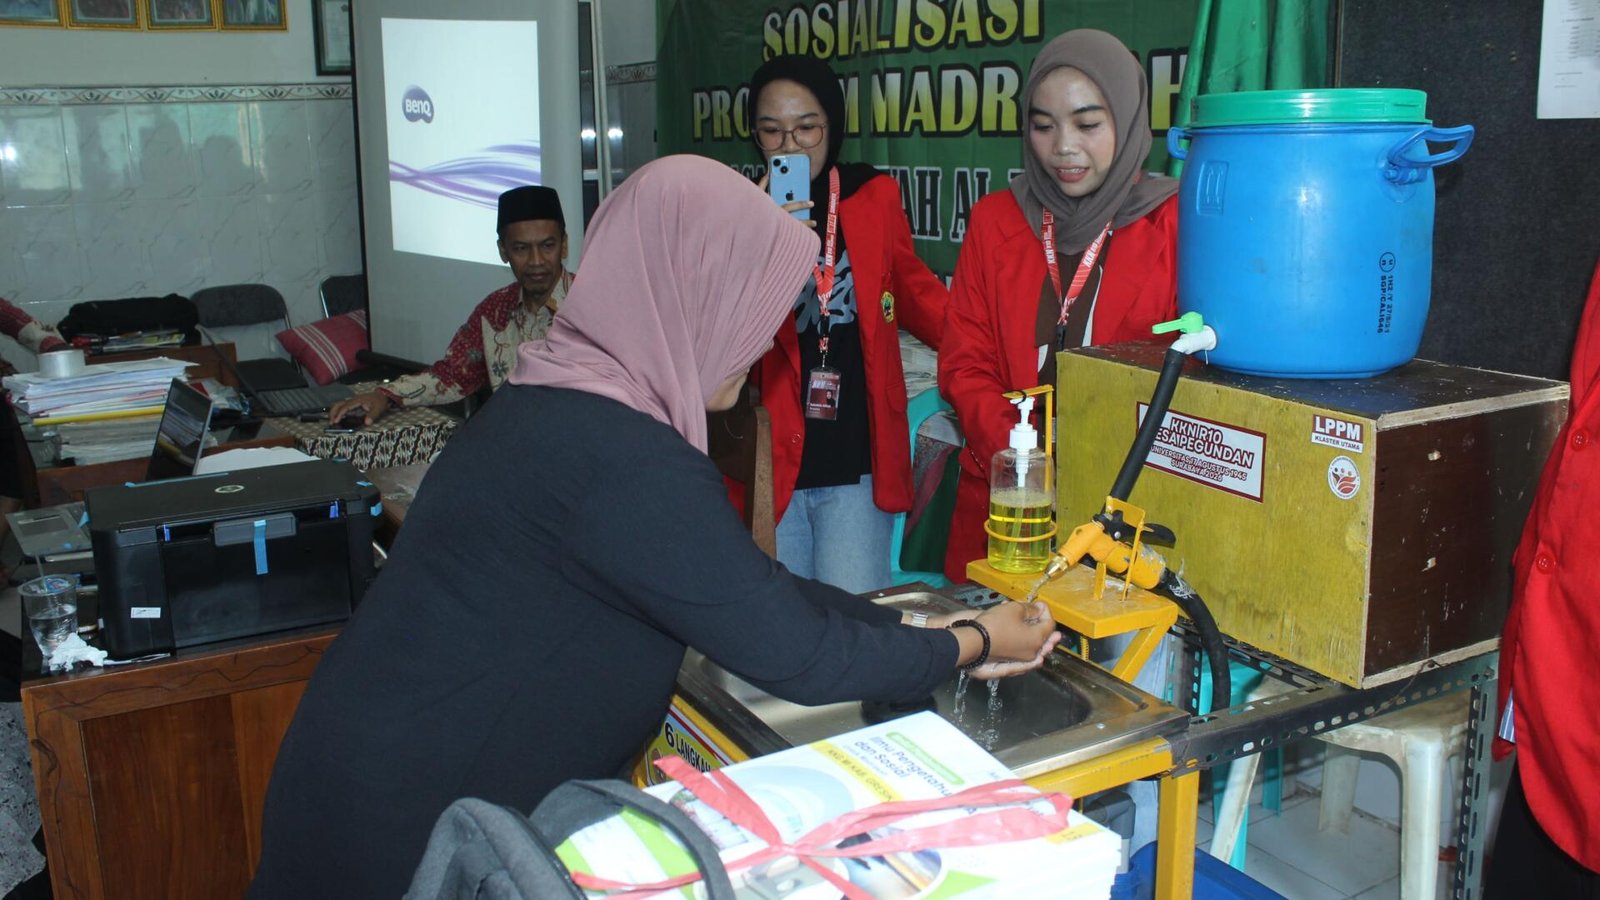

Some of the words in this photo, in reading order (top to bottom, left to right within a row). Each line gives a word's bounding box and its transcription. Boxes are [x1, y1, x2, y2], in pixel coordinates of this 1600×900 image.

[763, 0, 1041, 62] SOSIALISASI
[405, 98, 432, 117] BenQ
[693, 75, 860, 139] PROM
[870, 52, 1187, 134] MADRH
[1171, 417, 1197, 438] KKN
[1199, 425, 1223, 445] R10
[1314, 435, 1340, 446] KLASTER
[1340, 441, 1360, 450] UTAMA
[1315, 416, 1360, 440] LPPM
[1150, 445, 1190, 464] UNIVERSITAS
[1199, 459, 1230, 476] AGUSTUS
[1230, 468, 1248, 481] 1945
[1155, 427, 1179, 447] ESA
[1179, 434, 1254, 469] PEGUNDAN
[1171, 459, 1206, 476] SURABAYA
[665, 722, 675, 748] 6
[854, 741, 877, 755] dan
[875, 754, 910, 777] Sosial
[895, 751, 953, 797] Pengetahu
